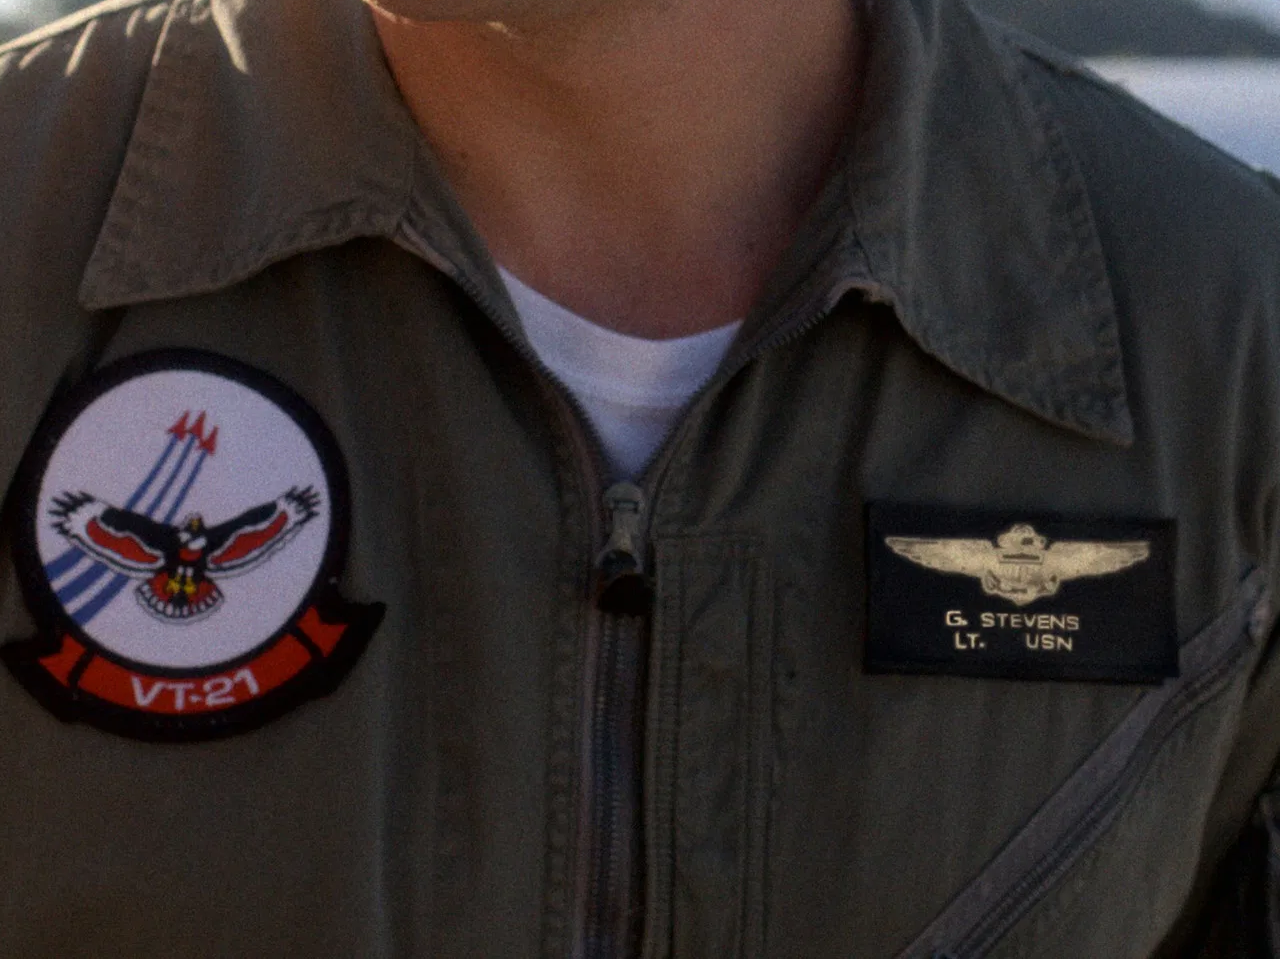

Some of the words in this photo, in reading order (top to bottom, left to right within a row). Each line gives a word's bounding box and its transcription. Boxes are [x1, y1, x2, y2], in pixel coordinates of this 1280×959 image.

[945, 610, 969, 627] G.
[980, 612, 1080, 631] STEVENS
[954, 632, 986, 650] LT.
[1025, 633, 1074, 652] USN
[130, 666, 260, 711] VT-21
